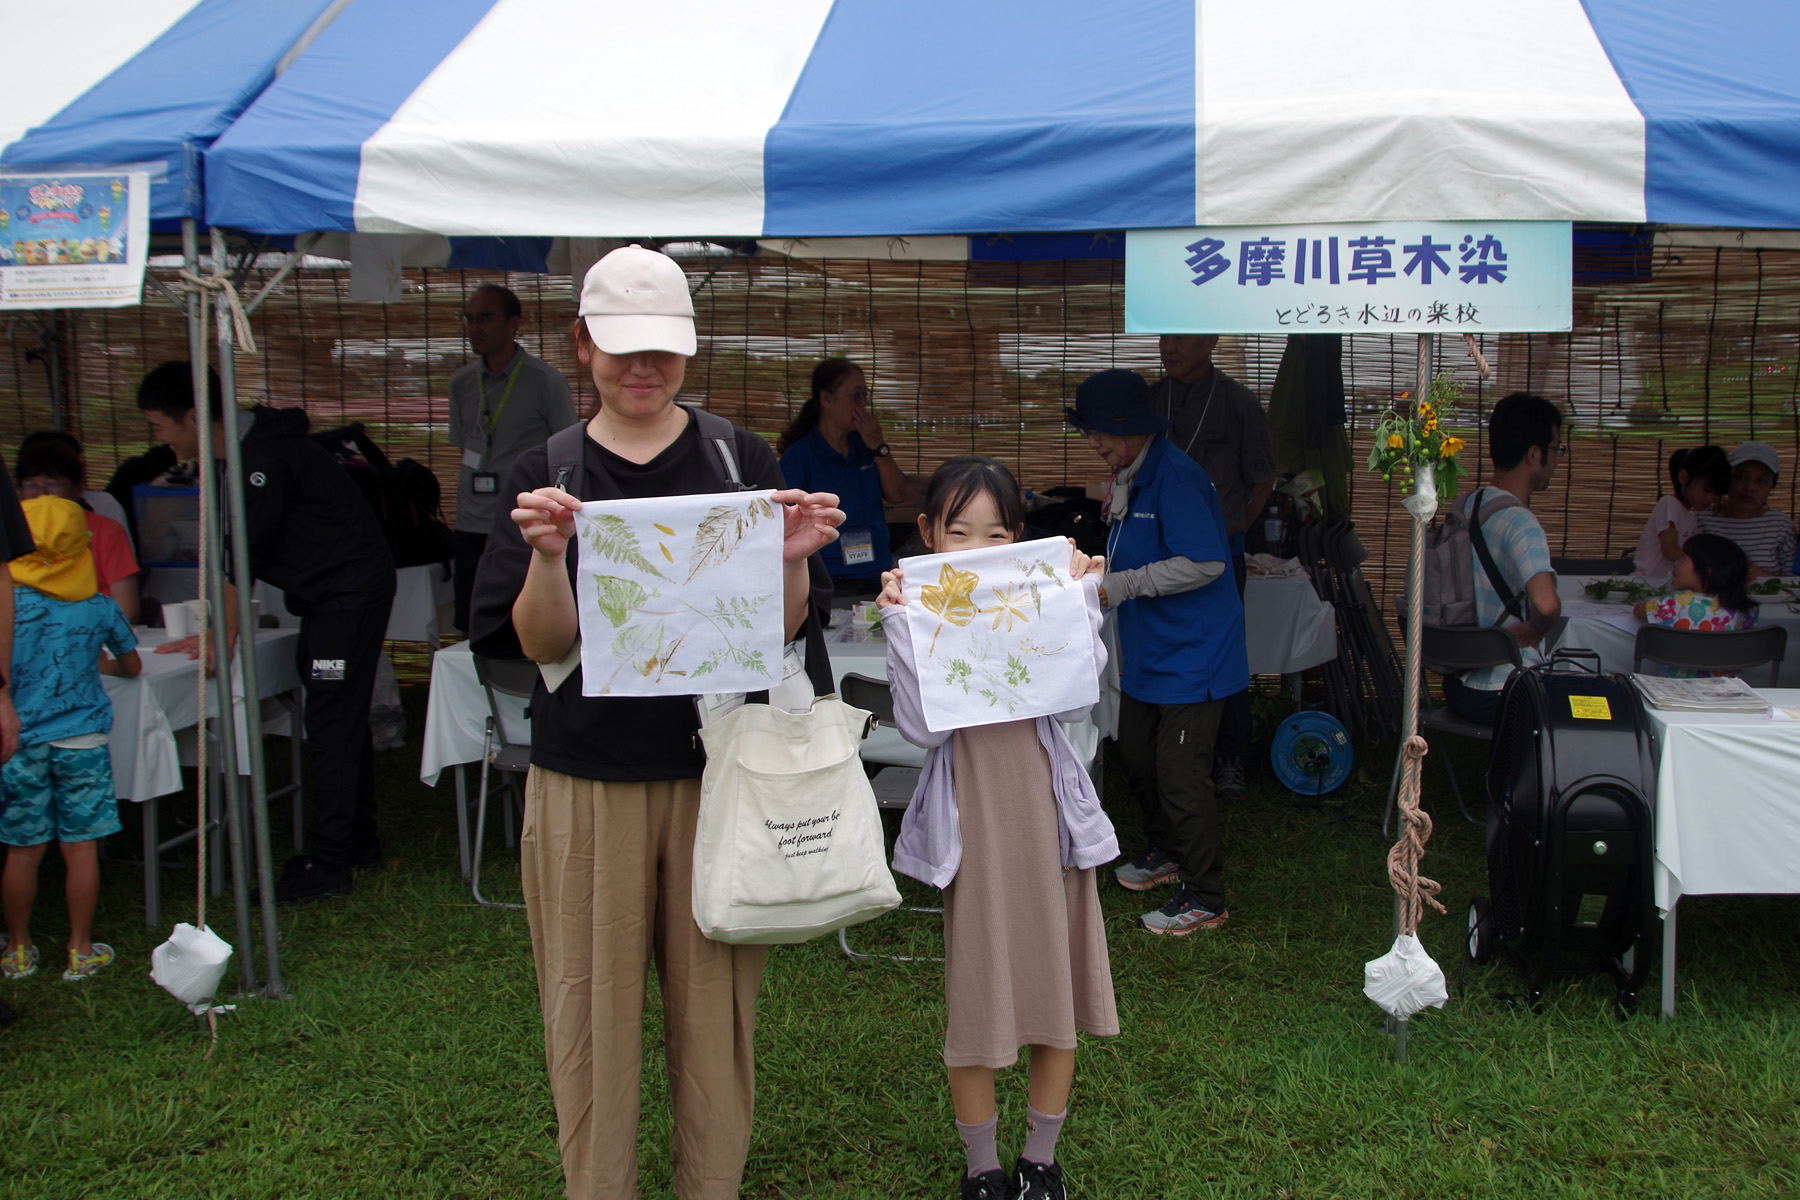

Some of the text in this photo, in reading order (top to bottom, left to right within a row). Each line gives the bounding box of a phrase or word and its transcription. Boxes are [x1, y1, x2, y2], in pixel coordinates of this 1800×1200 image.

[1184, 234, 1508, 287] 多摩川草木染
[1276, 300, 1482, 325] とどろき水辺の楽校
[312, 659, 346, 670] NIKE
[796, 817, 812, 831] put
[812, 815, 830, 828] your
[778, 827, 833, 849] foot forward
